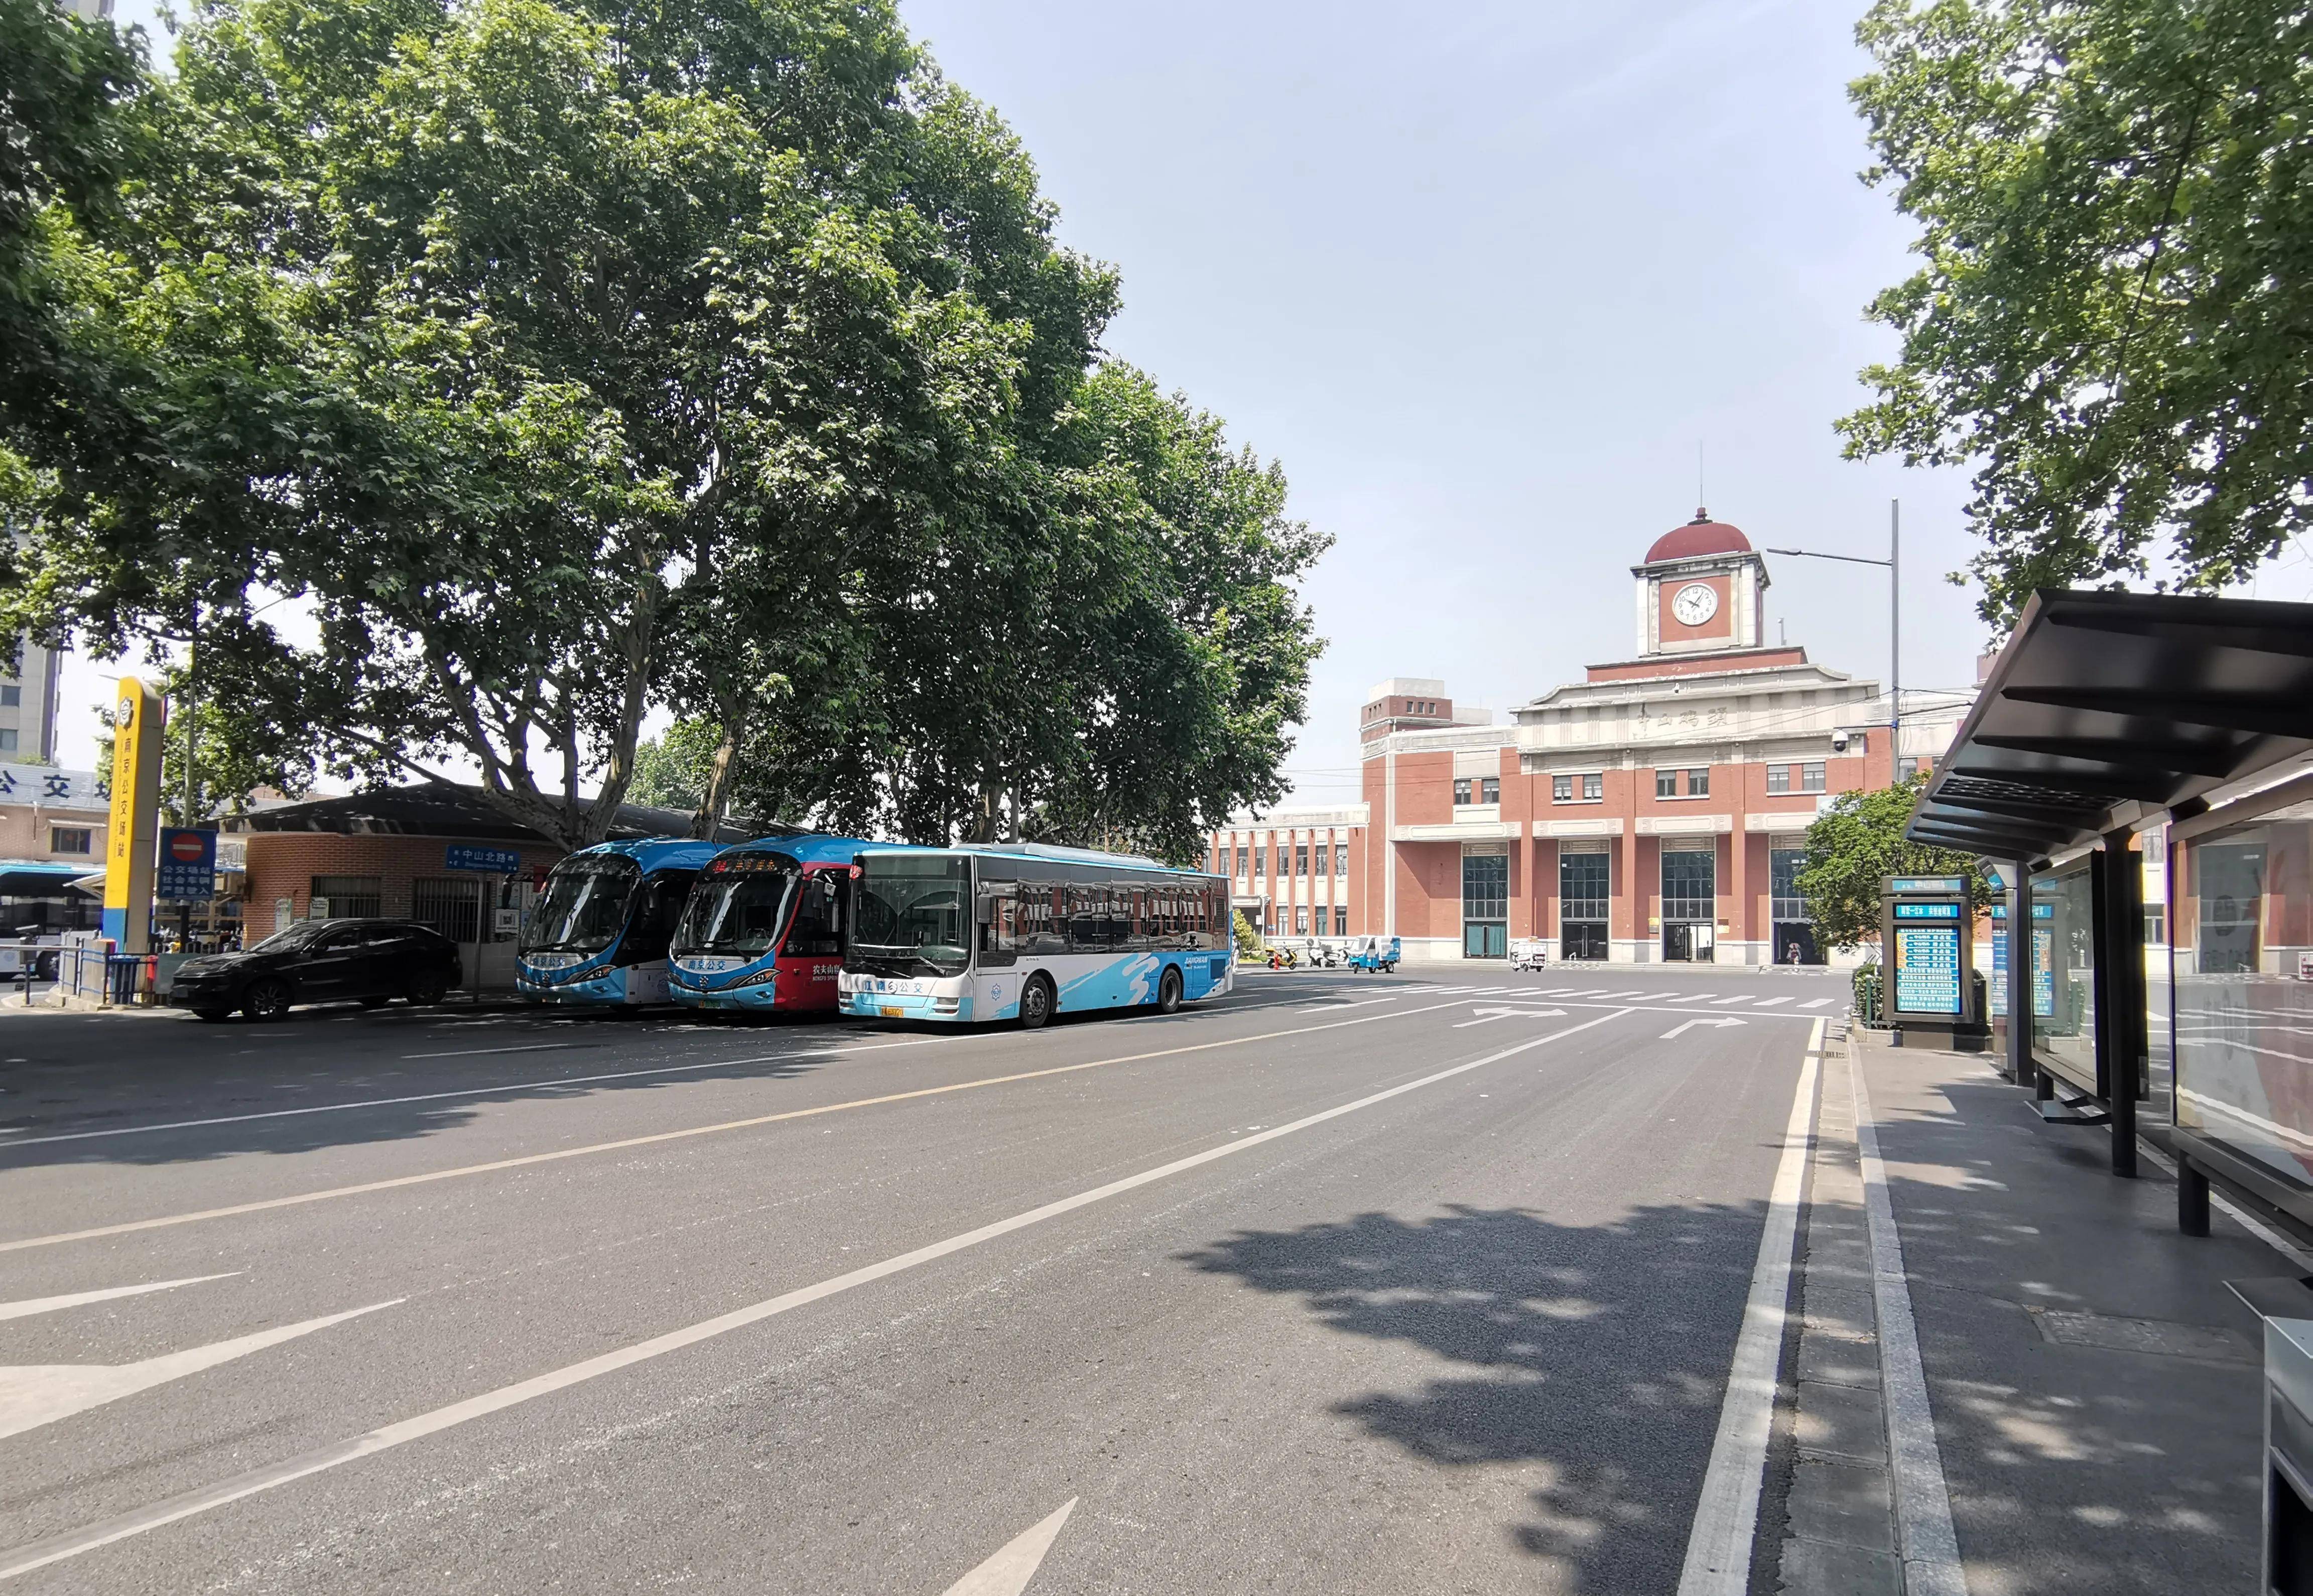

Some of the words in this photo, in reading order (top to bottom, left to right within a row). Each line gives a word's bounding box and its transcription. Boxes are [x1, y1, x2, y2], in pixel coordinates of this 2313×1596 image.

[117, 738, 131, 857] 南京公交场站
[462, 849, 505, 863] 中山北路
[163, 866, 210, 874] 公交场站
[688, 960, 726, 970] 南京公交
[864, 980, 885, 992] 江南
[900, 982, 924, 993] 公交
